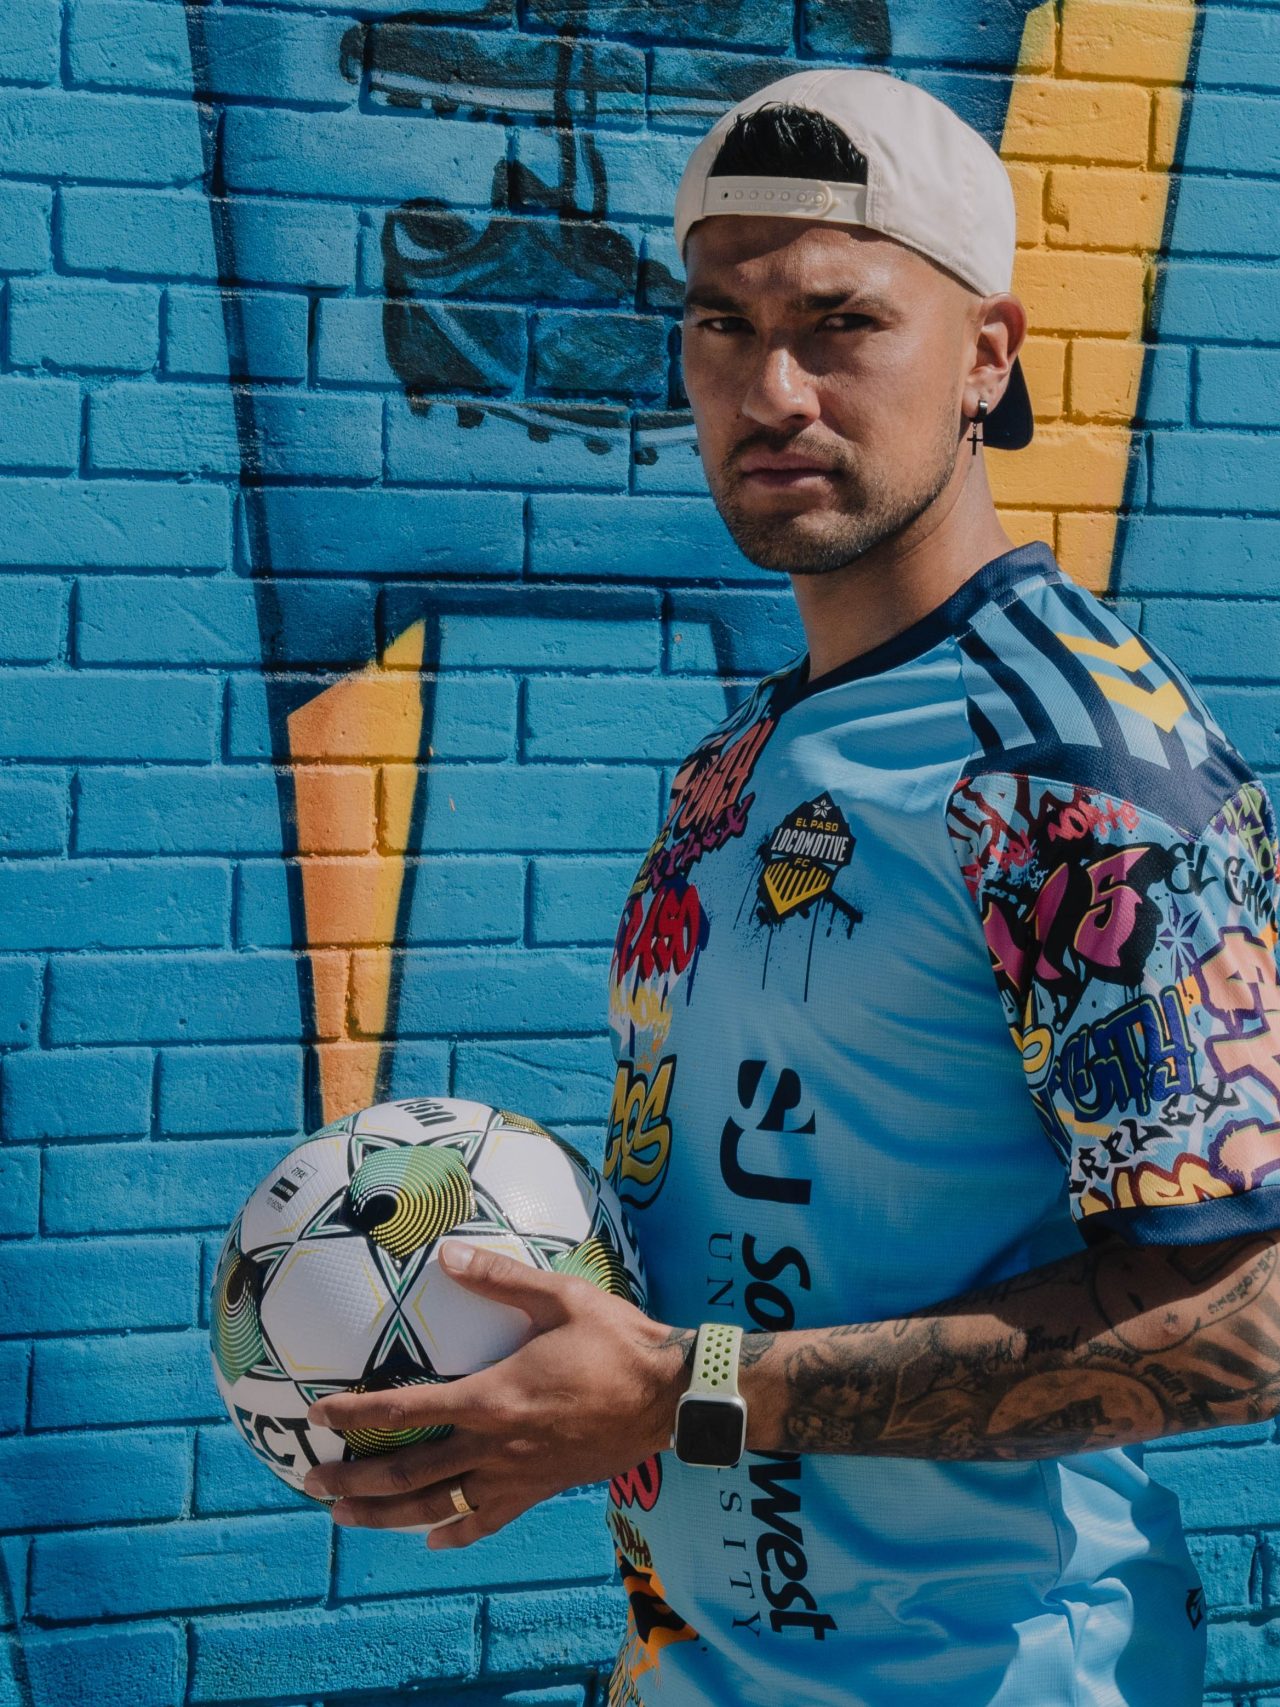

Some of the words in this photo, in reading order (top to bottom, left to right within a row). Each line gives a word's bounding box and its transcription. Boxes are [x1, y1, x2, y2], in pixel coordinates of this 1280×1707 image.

[795, 817, 808, 828] EL
[810, 819, 839, 832] PASO
[770, 827, 849, 862] LOCOMOTIVE
[794, 857, 811, 868] FC
[706, 1230, 762, 1638] UNSITY
[741, 1232, 838, 1641] Sowest
